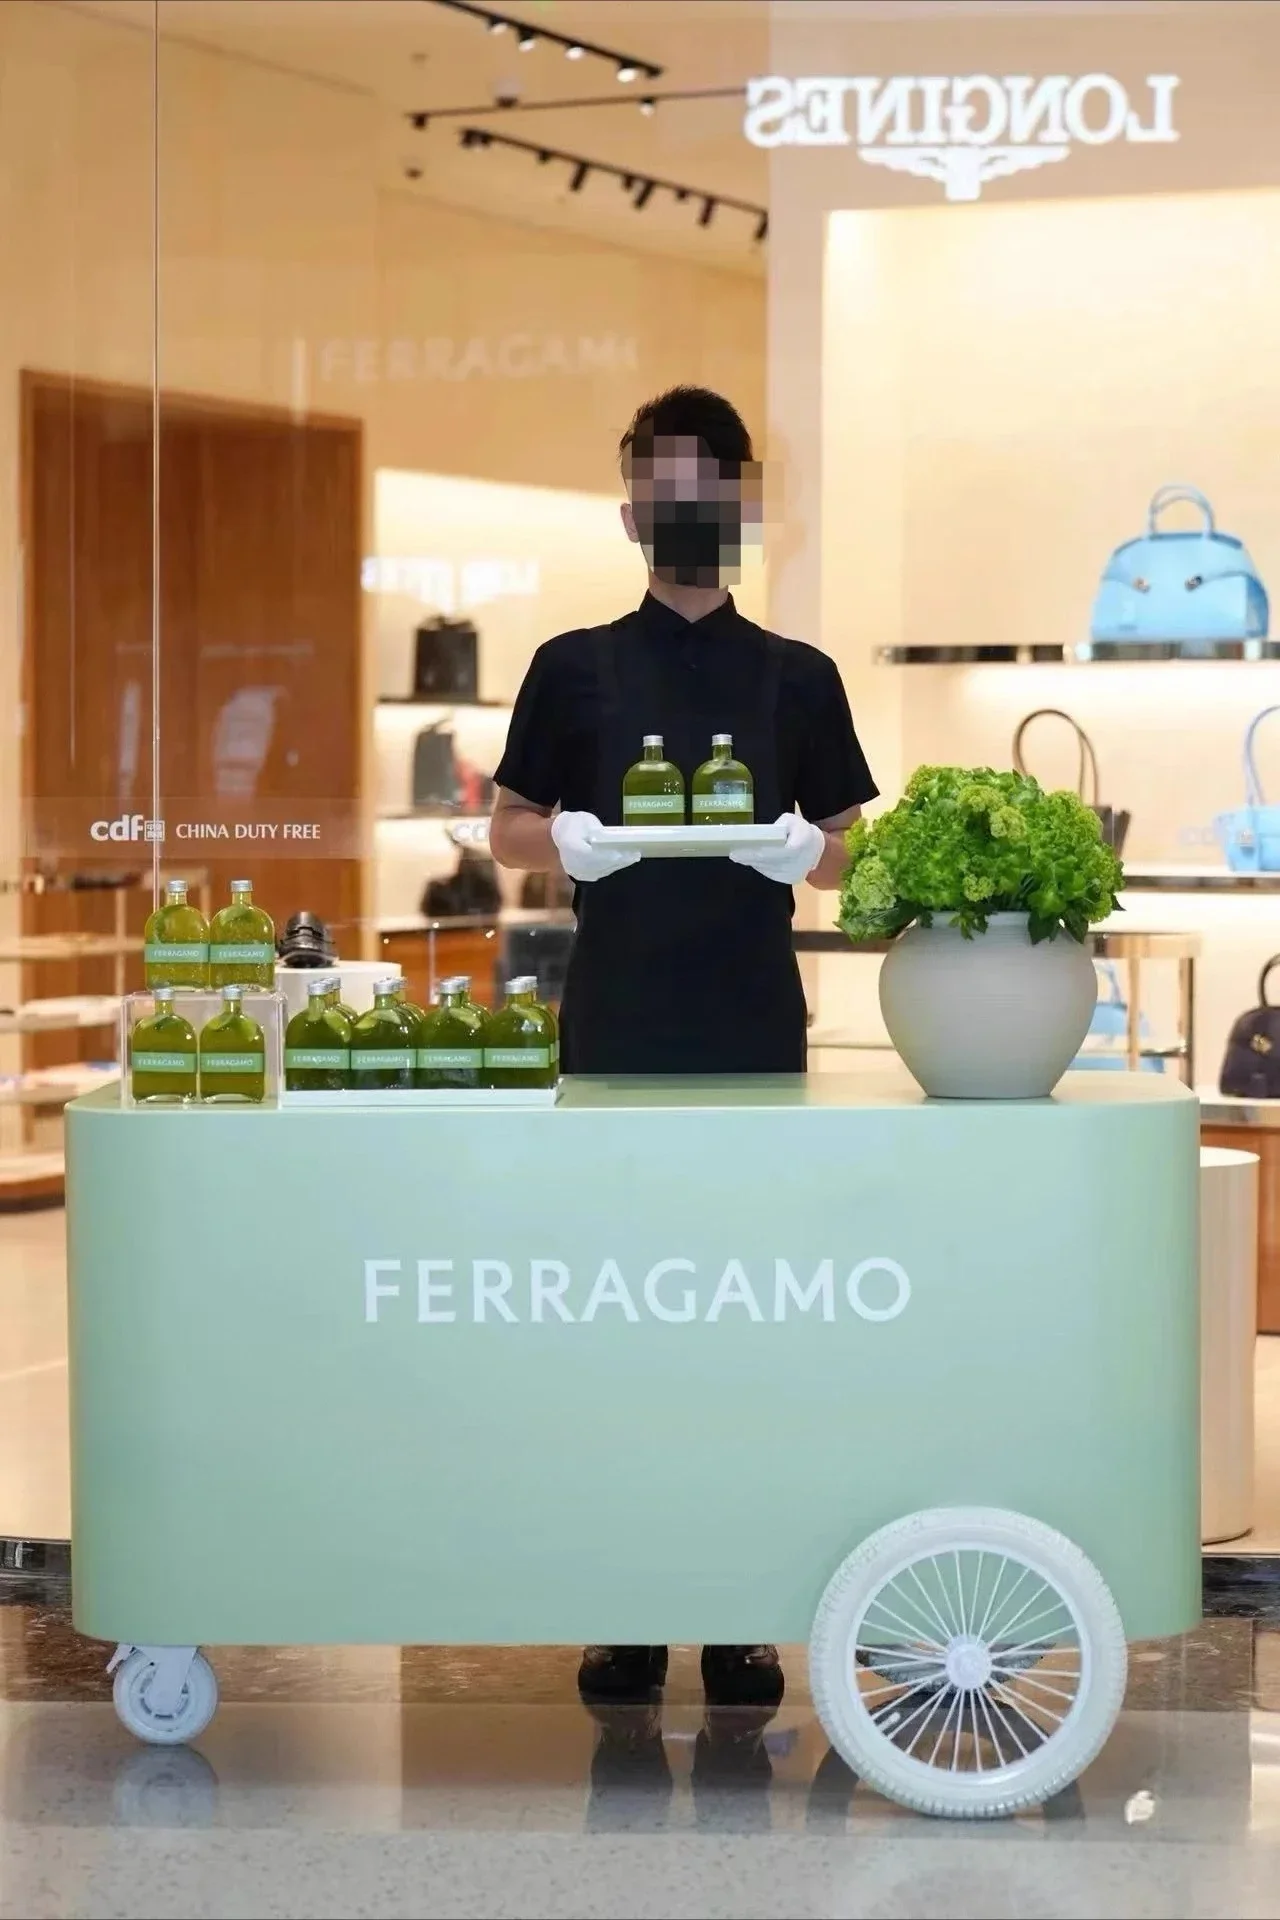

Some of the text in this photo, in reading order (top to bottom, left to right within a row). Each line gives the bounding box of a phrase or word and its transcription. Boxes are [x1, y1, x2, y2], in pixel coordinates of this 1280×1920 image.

[90, 814, 144, 841] cdf
[175, 823, 229, 839] CHINA
[235, 823, 278, 839] DUTY
[283, 823, 321, 839] FREE
[363, 1257, 911, 1323] FERRAGAMO
